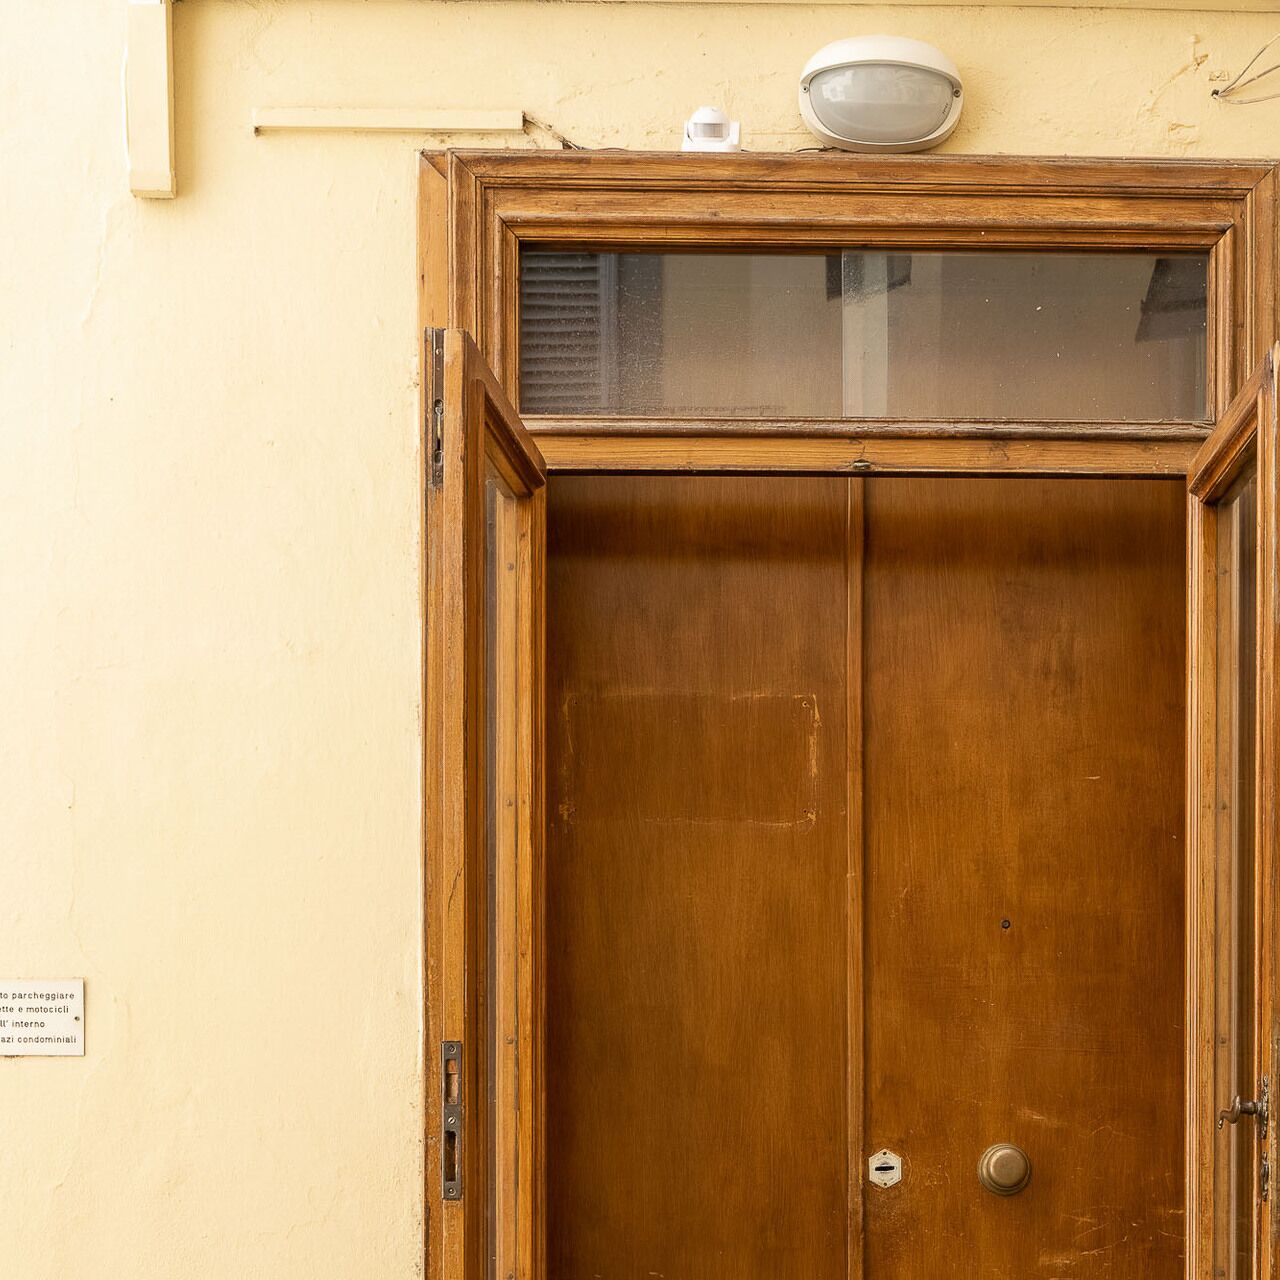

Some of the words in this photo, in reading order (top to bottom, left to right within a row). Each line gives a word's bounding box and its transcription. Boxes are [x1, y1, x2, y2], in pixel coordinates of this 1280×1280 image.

[11, 992, 75, 1001] parcheggiare
[26, 1005, 69, 1013] motocicli
[11, 1020, 45, 1028] interno
[17, 1035, 77, 1043] condominiali
